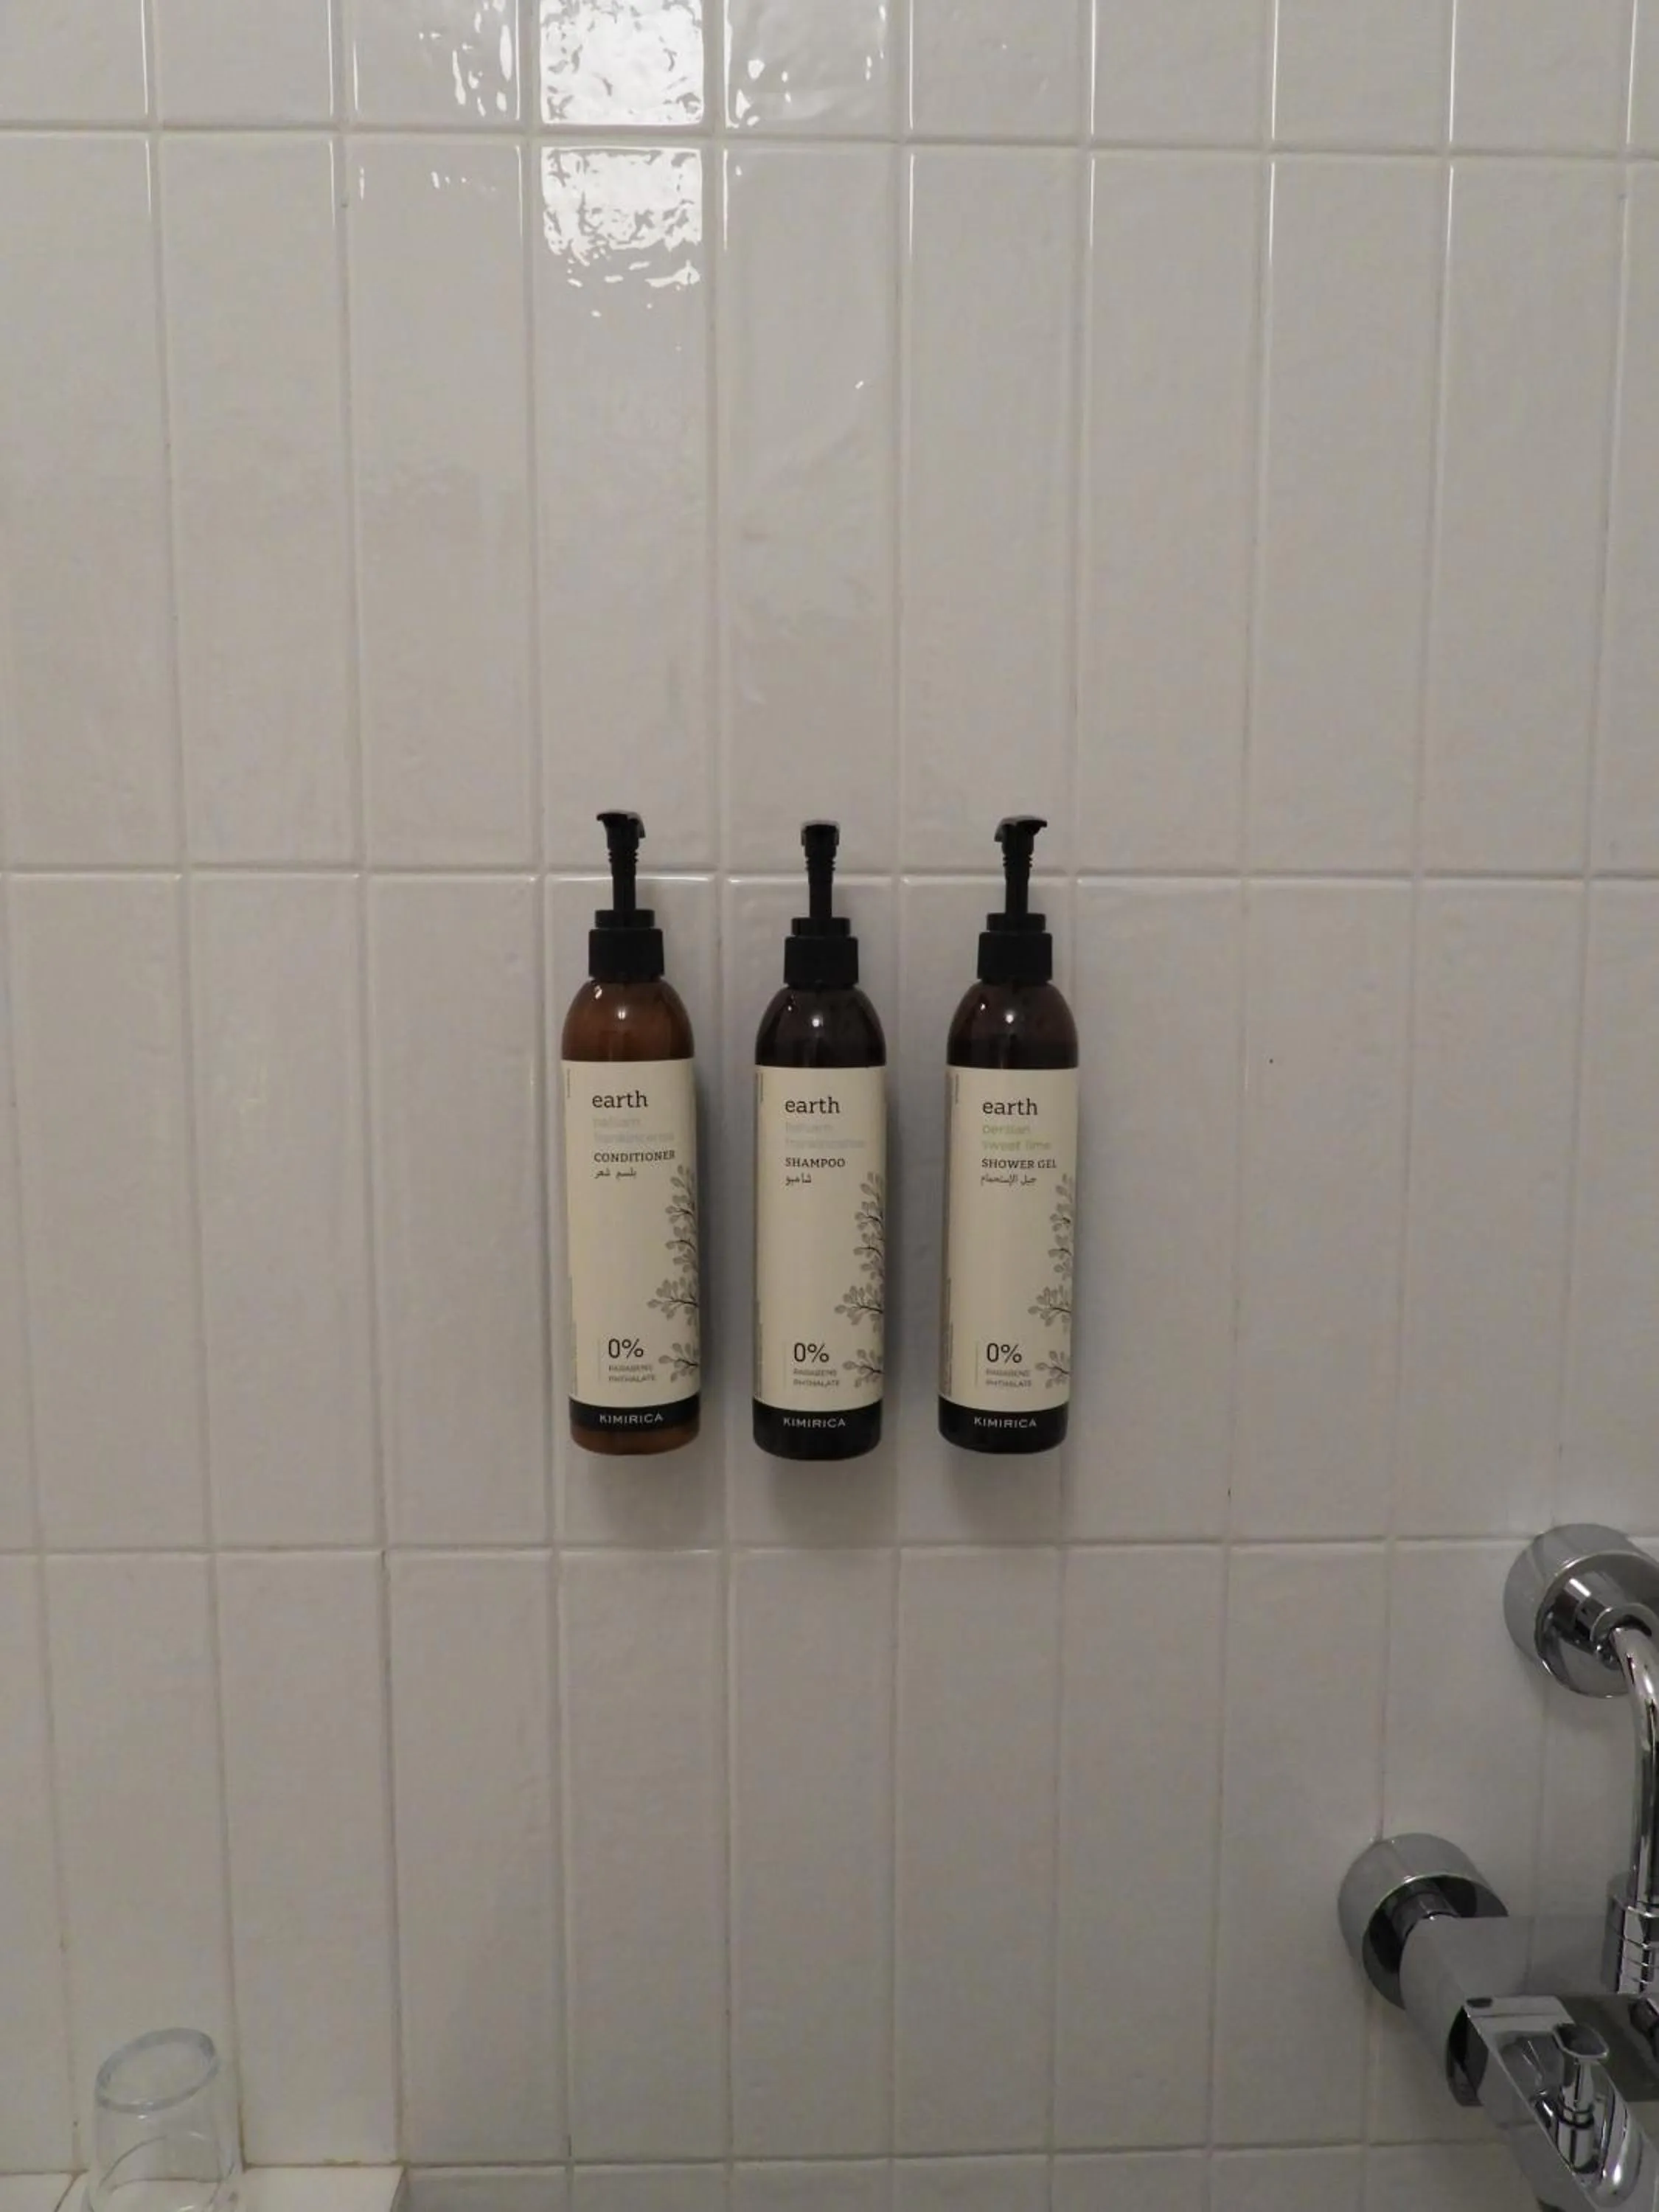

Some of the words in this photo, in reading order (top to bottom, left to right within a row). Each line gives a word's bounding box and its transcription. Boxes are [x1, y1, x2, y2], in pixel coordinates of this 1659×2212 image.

[592, 1090, 648, 1108] earth
[785, 1096, 841, 1114] earth
[982, 1098, 1038, 1116] earth
[594, 1150, 675, 1163] CONDITIONER
[785, 1157, 846, 1168] SHAMPOO
[981, 1158, 1034, 1169] SHOWER
[1037, 1159, 1057, 1169] GEL
[608, 1338, 644, 1358] 0%
[794, 1343, 830, 1363] 0%
[987, 1343, 1023, 1363] 0%
[599, 1412, 664, 1424] KIMIRICA
[783, 1417, 846, 1428] KIMIRICA
[974, 1416, 1037, 1428] KIMIRICA
